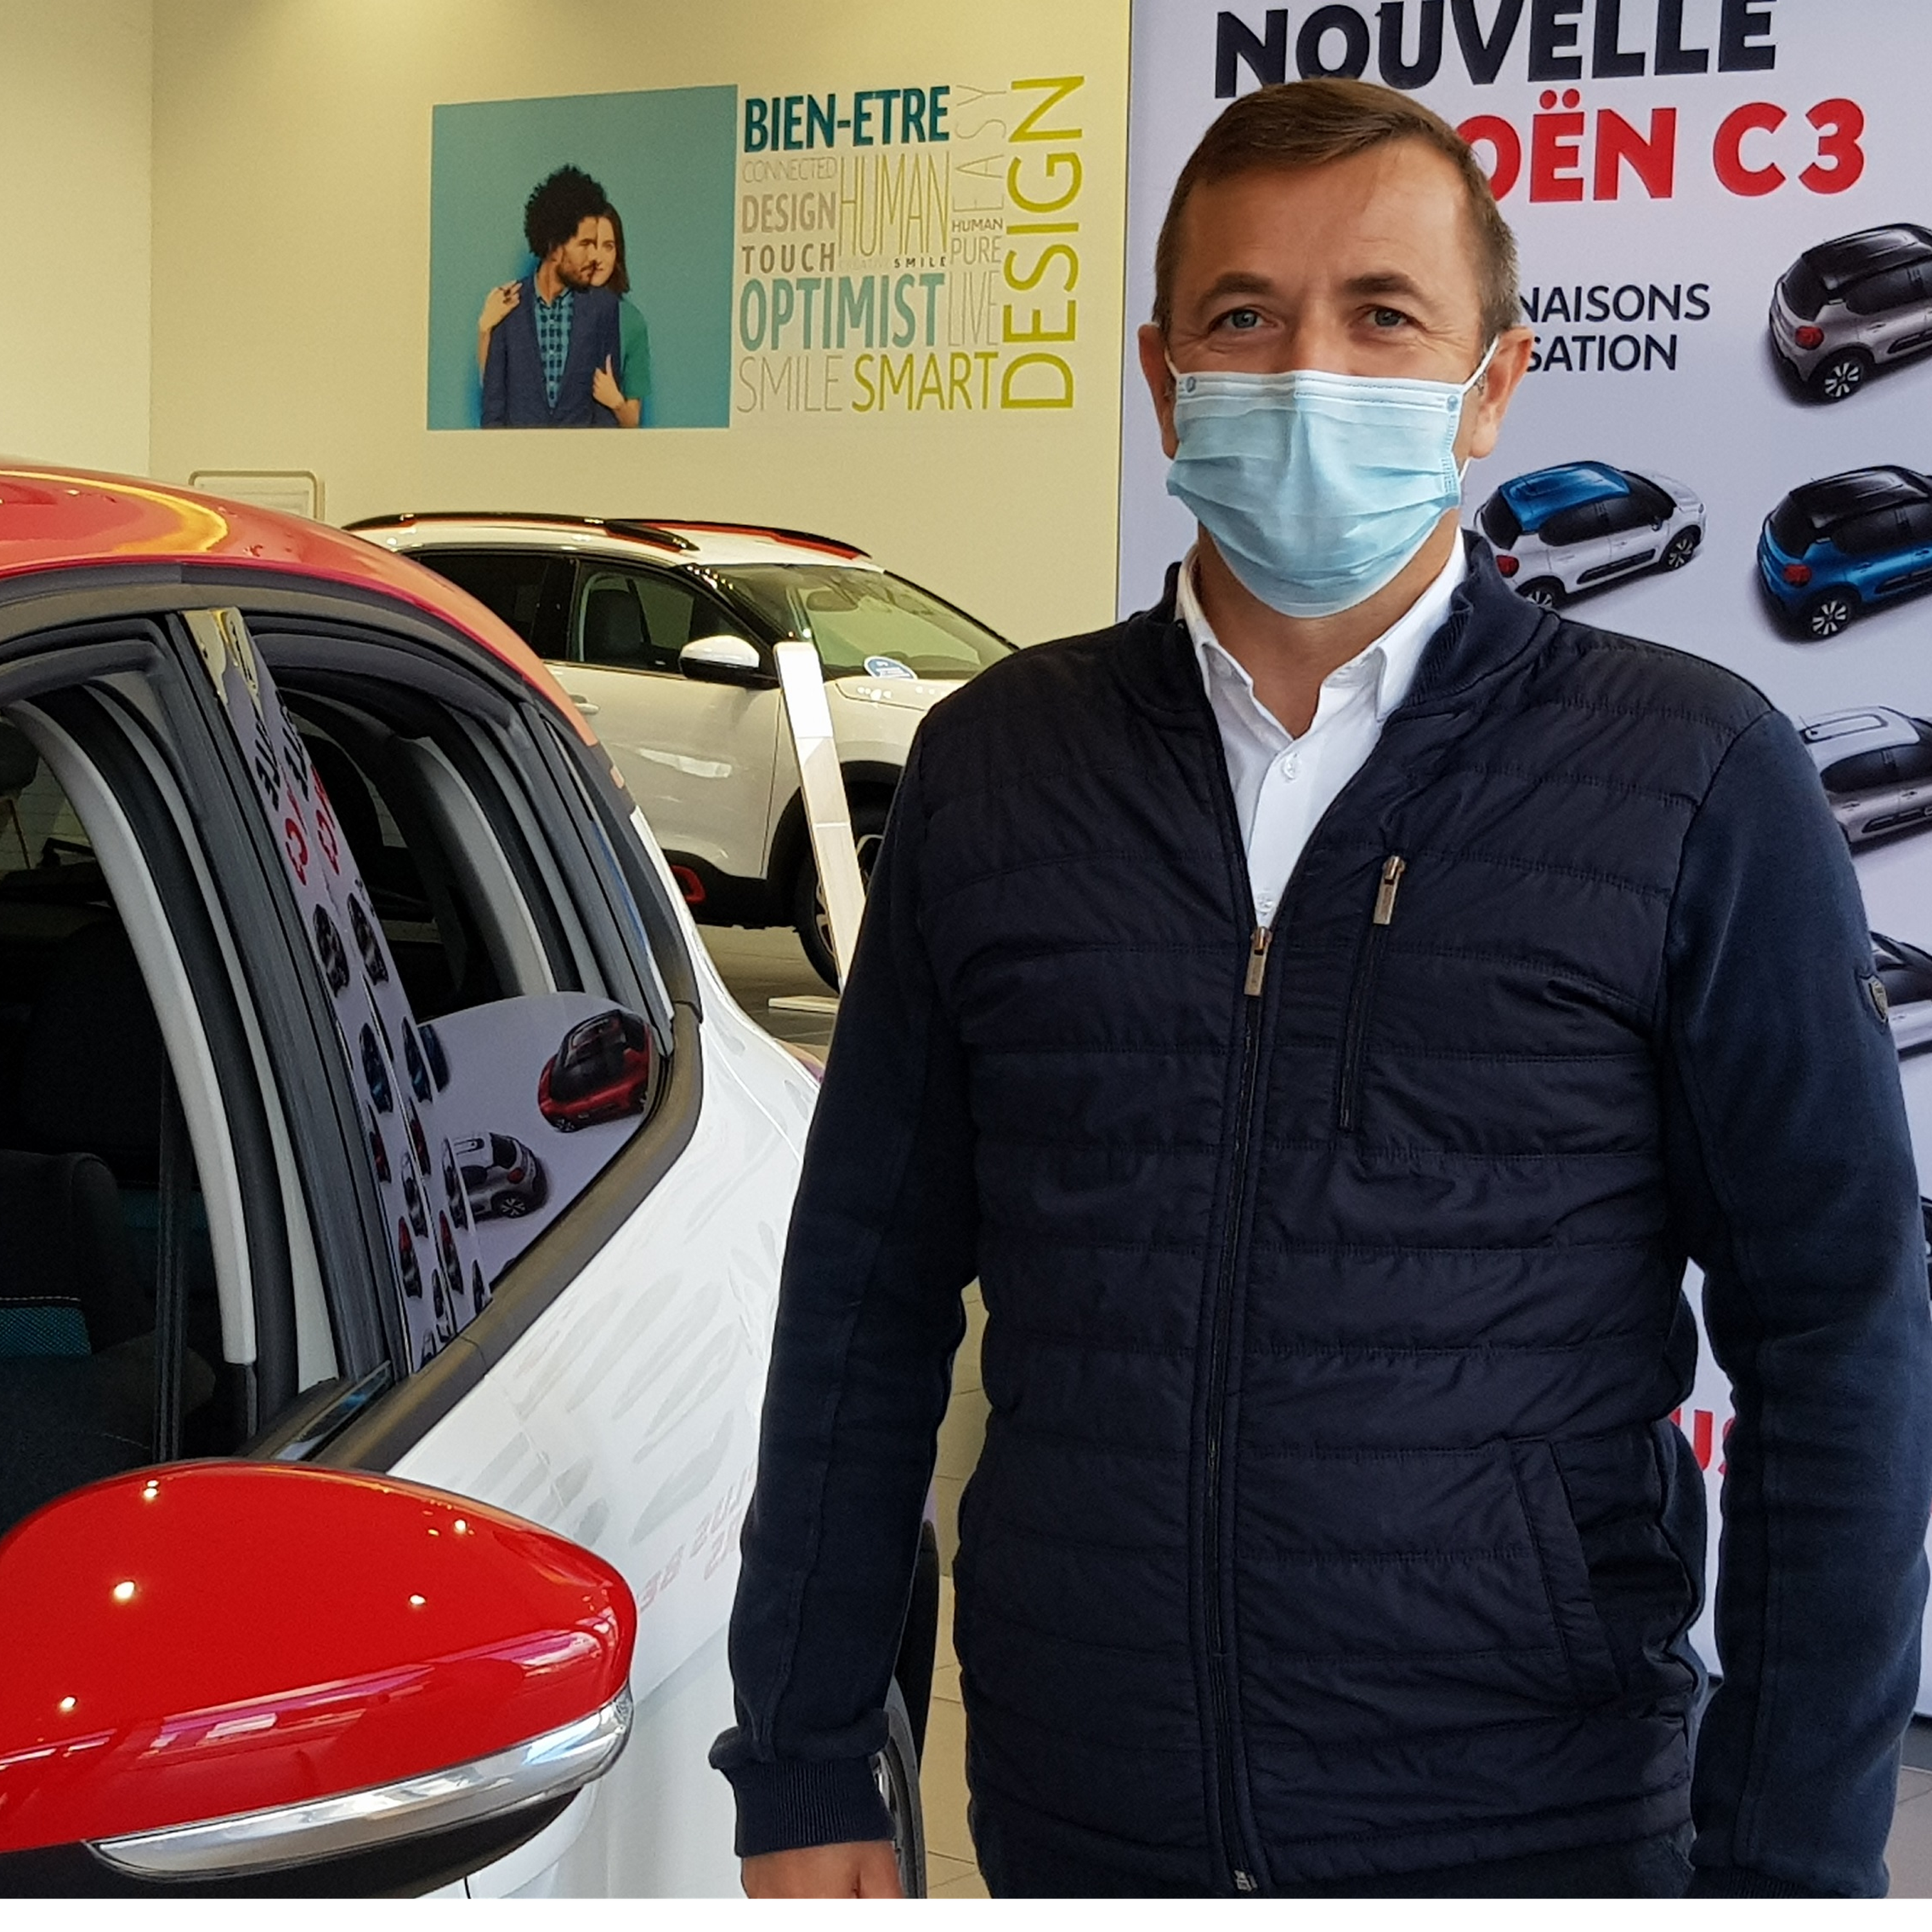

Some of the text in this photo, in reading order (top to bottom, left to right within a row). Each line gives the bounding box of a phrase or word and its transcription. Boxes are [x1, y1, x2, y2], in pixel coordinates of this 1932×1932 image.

[1215, 0, 1776, 99] NOUVELLE
[744, 85, 950, 153] BIEN-ETRE
[952, 84, 1007, 212] EASY
[742, 156, 837, 183] CONNECTED
[742, 192, 836, 234] DESIGN
[838, 151, 949, 257] HUMAN
[951, 218, 1003, 232] HUMAN
[742, 242, 835, 275] TOUCH
[895, 257, 946, 268] SMILE
[950, 236, 1002, 265] PURE
[1000, 75, 1084, 410] DESIGN
[740, 272, 945, 352] OPTIMIST
[948, 270, 999, 346] LIVE
[737, 355, 843, 412] SMILE
[852, 352, 999, 412] SMART
